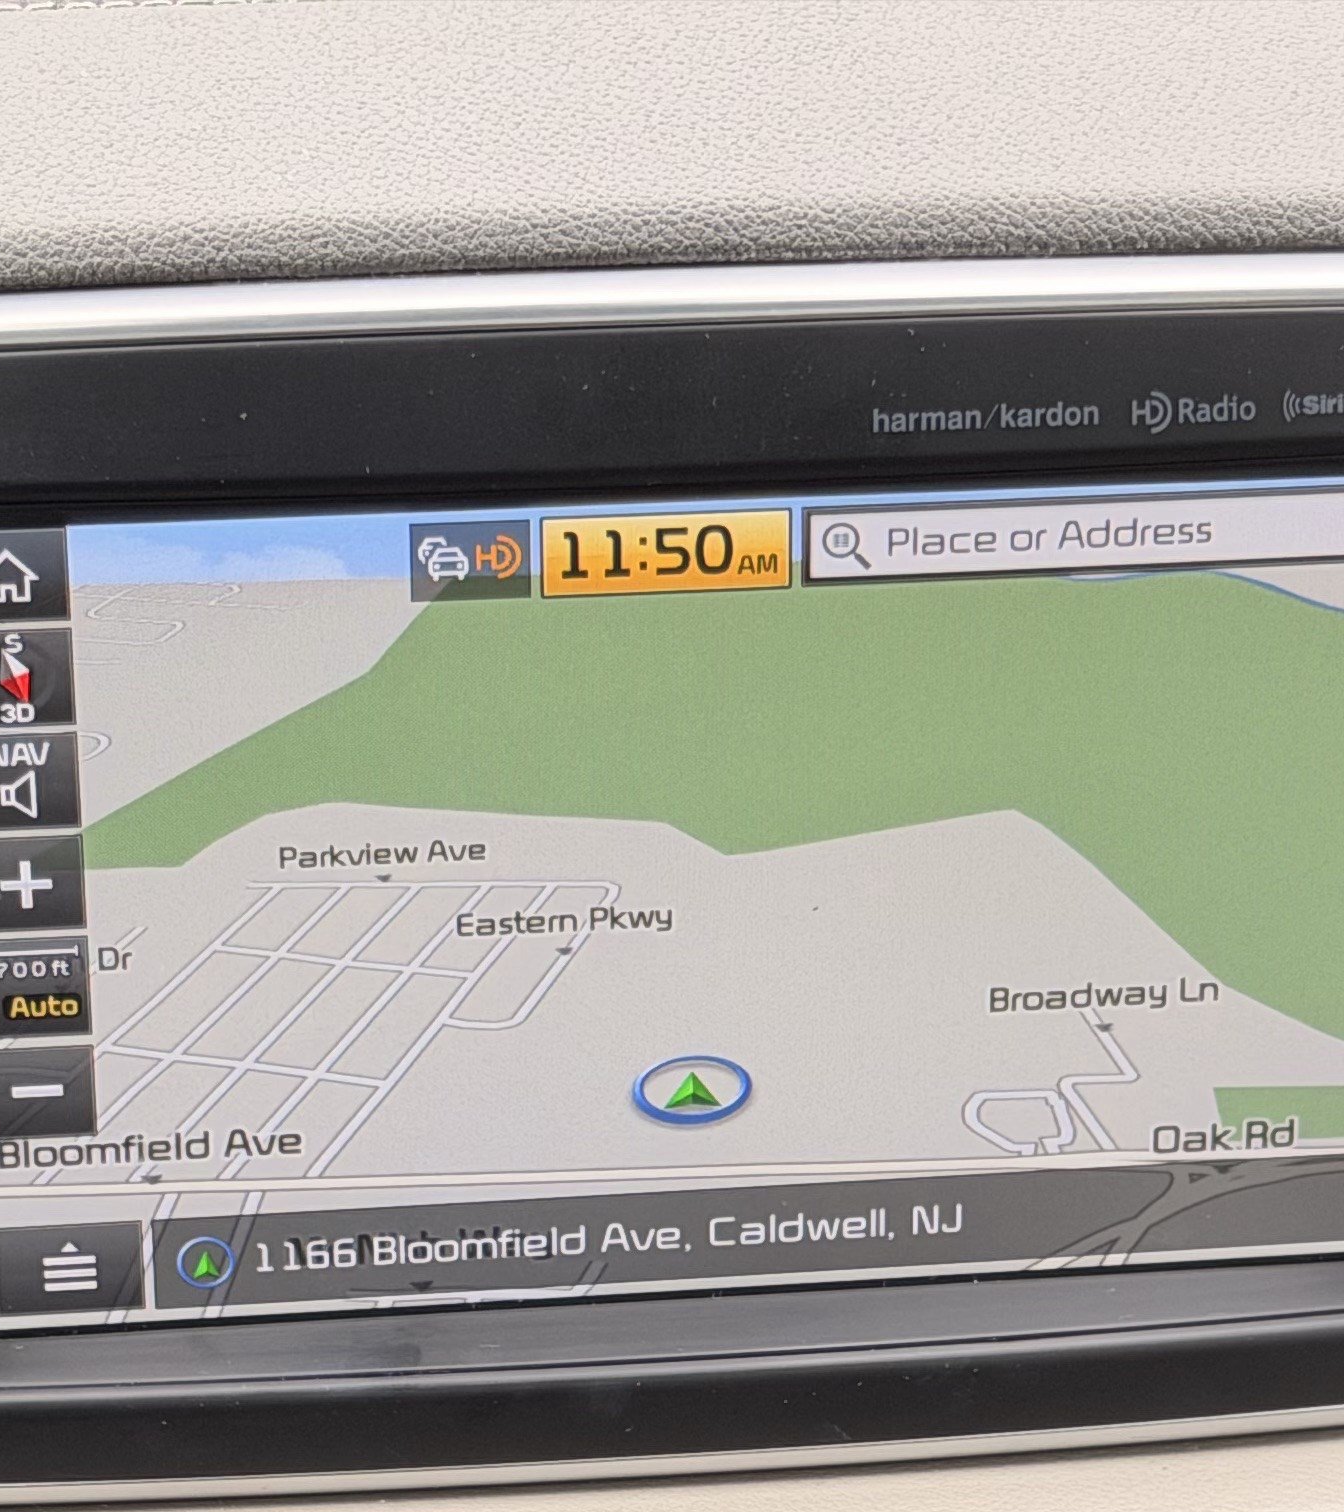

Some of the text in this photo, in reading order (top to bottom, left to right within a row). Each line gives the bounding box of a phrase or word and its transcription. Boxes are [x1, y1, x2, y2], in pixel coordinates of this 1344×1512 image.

[872, 402, 1100, 434] harman/kardon
[1178, 393, 1256, 424] Radio
[561, 524, 778, 580] 11:50 AM
[886, 517, 1212, 558] Place or Address
[4, 633, 23, 654] S
[0, 703, 36, 724] 3D
[278, 840, 487, 870] Parkview Ave
[456, 905, 674, 938] Eastern Pkwy
[98, 947, 132, 971] Dr
[10, 995, 79, 1019] Auto
[988, 976, 1220, 1014] Broadway Ln
[225, 1128, 303, 1158] Ave
[1151, 1117, 1297, 1154] Oak Rd
[256, 1237, 358, 1272] 1166
[373, 1224, 586, 1266] Bloomfield
[601, 1224, 692, 1254] Ave,
[708, 1207, 895, 1248] Caldwell,
[912, 1203, 964, 1235] NJ
